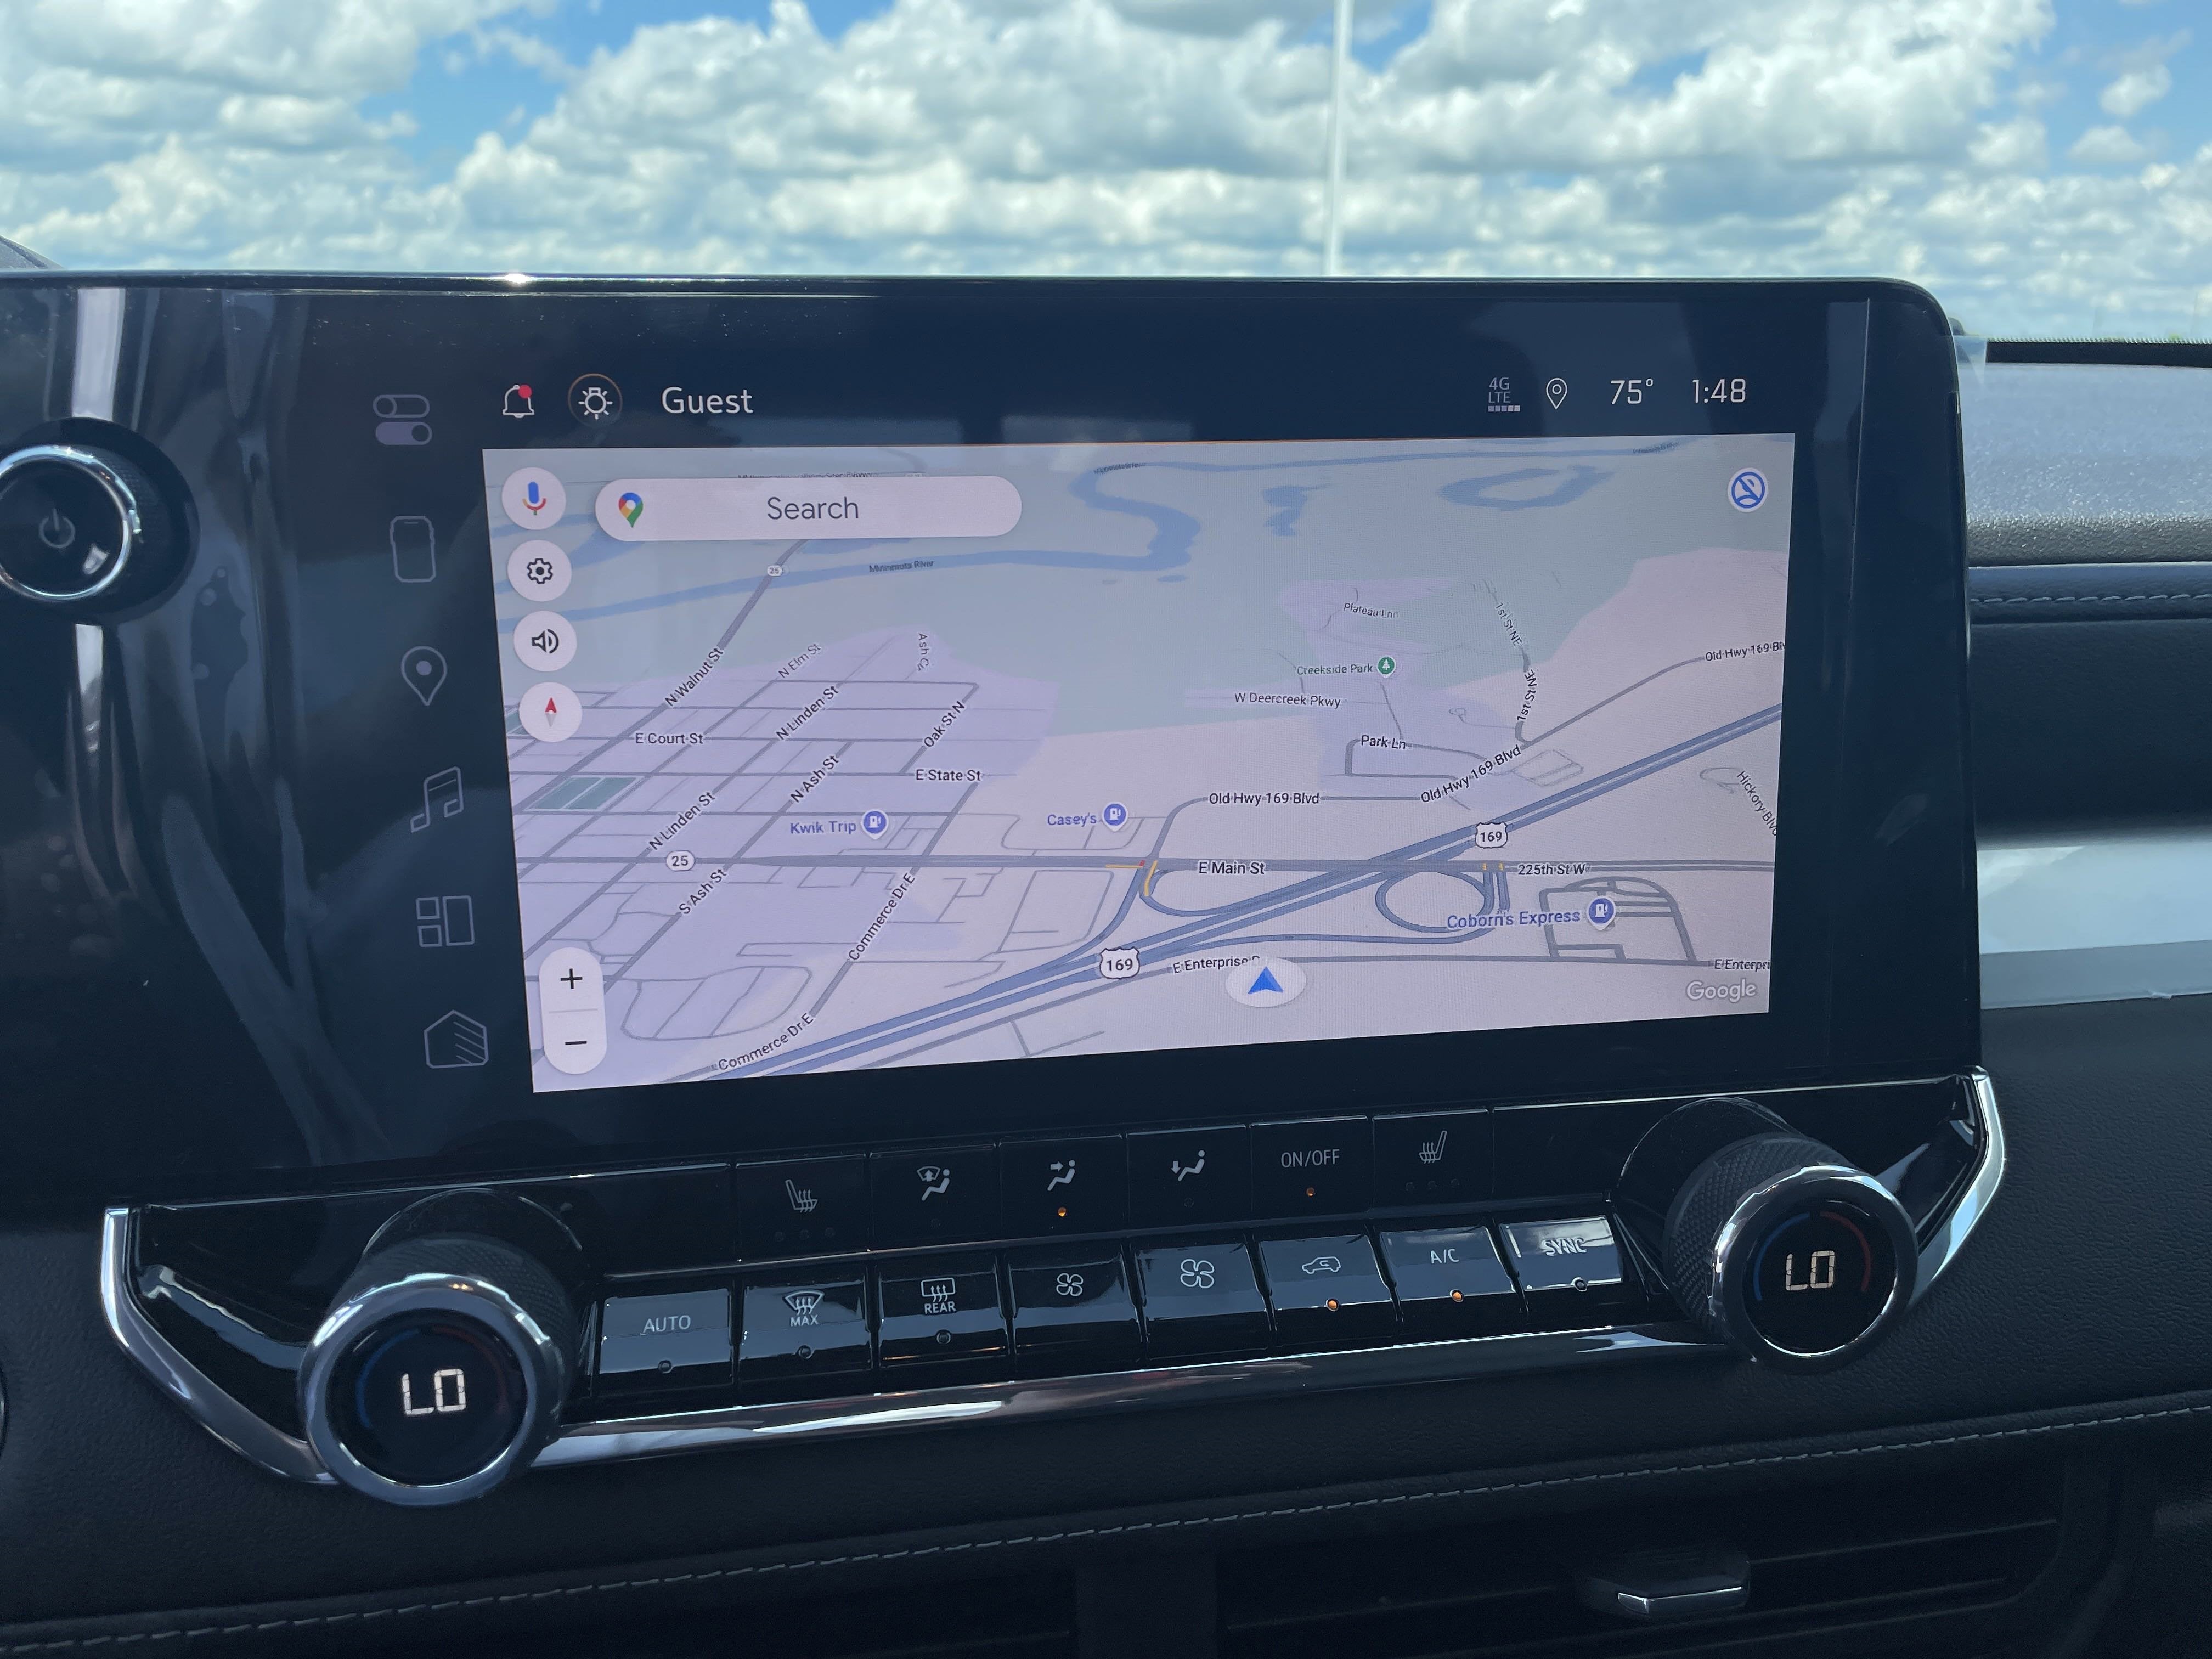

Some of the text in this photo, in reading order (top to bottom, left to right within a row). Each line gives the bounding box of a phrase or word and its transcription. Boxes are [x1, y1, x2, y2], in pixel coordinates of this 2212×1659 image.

[1489, 377, 1510, 391] 4G
[1610, 379, 1654, 405] 75°
[1692, 379, 1747, 404] 1:48
[661, 386, 754, 414] Guest
[1488, 391, 1511, 403] LTE
[767, 496, 859, 520] Search
[1344, 602, 1379, 617] Plateau
[1496, 602, 1522, 647] 1st St NE
[918, 633, 930, 655] Ash
[1705, 650, 1722, 662] Old
[1724, 647, 1748, 659] Hwy
[1751, 642, 1770, 655] 169
[778, 643, 821, 678] N Elm St
[1297, 663, 1373, 676] Creekside Park
[664, 647, 724, 707] N Walnut St
[1234, 692, 1341, 710] W Deercreek Pkwy
[1516, 669, 1537, 721] 1st St NE
[776, 685, 839, 741] N Linden St
[923, 699, 966, 748] Oak St N
[635, 732, 704, 744] E Court St
[1361, 735, 1407, 750] Park Ln
[789, 755, 839, 803] N Ash St
[916, 769, 982, 782] E State St
[1420, 744, 1522, 804] Old Hwy 169 Blvd
[1209, 792, 1320, 807] Old Hwy 169 Blvd
[1736, 770, 1766, 812] Hickory
[648, 791, 715, 850] N Linden St
[790, 820, 857, 834] Kwik Trip
[1047, 812, 1097, 826] Casey's
[1480, 831, 1503, 843] 169
[670, 855, 689, 867] 25
[1199, 861, 1265, 874] E Main St
[1517, 863, 1586, 876] 225th St W
[678, 868, 727, 915] S Ash St
[848, 872, 916, 961] Commerce Dr E
[1447, 910, 1581, 929] Coborn's Express
[1106, 958, 1133, 972] 169
[1173, 961, 1182, 974] E
[1714, 958, 1723, 969] E
[1686, 978, 1757, 1003] Google
[718, 1012, 814, 1071] Commerce Dr E
[1280, 1149, 1340, 1169] ON/OFF
[1430, 1248, 1460, 1265] A/C
[1542, 1237, 1588, 1256] SYNC
[1785, 1250, 1836, 1291] LO
[924, 1301, 956, 1315] REAR
[642, 1314, 692, 1334] AUTO
[790, 1314, 820, 1328] MAX
[400, 1368, 466, 1416] LO
